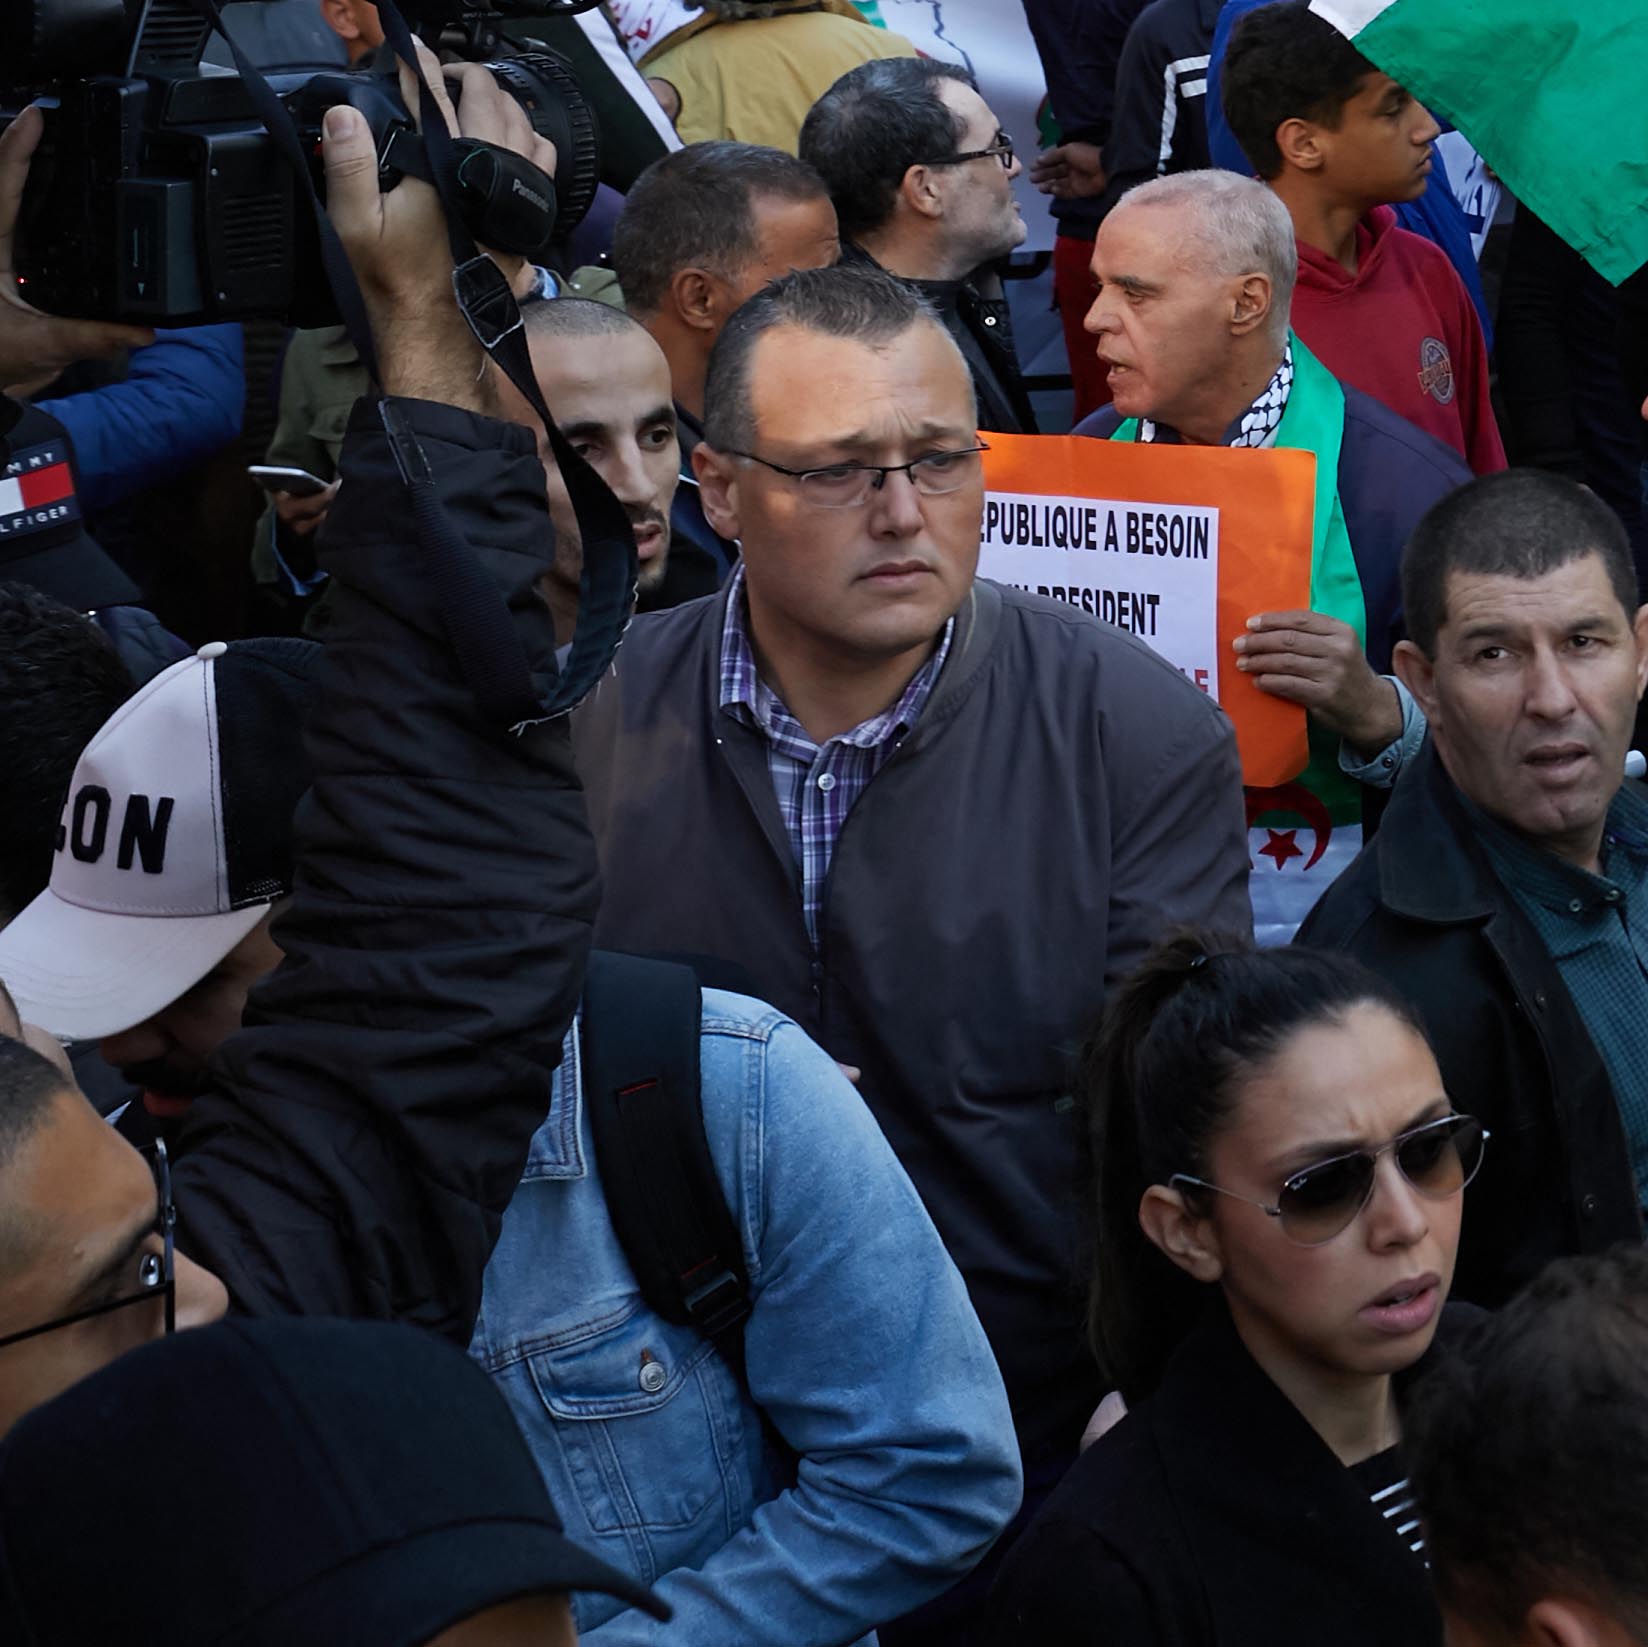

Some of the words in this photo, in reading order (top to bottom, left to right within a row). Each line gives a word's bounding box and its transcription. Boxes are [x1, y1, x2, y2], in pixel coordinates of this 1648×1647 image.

[512, 178, 550, 213] Panasonic
[980, 501, 1097, 551] PUBLIQUE
[1104, 510, 1119, 553] A
[1126, 511, 1209, 559] BESOIN
[54, 784, 175, 874] ON
